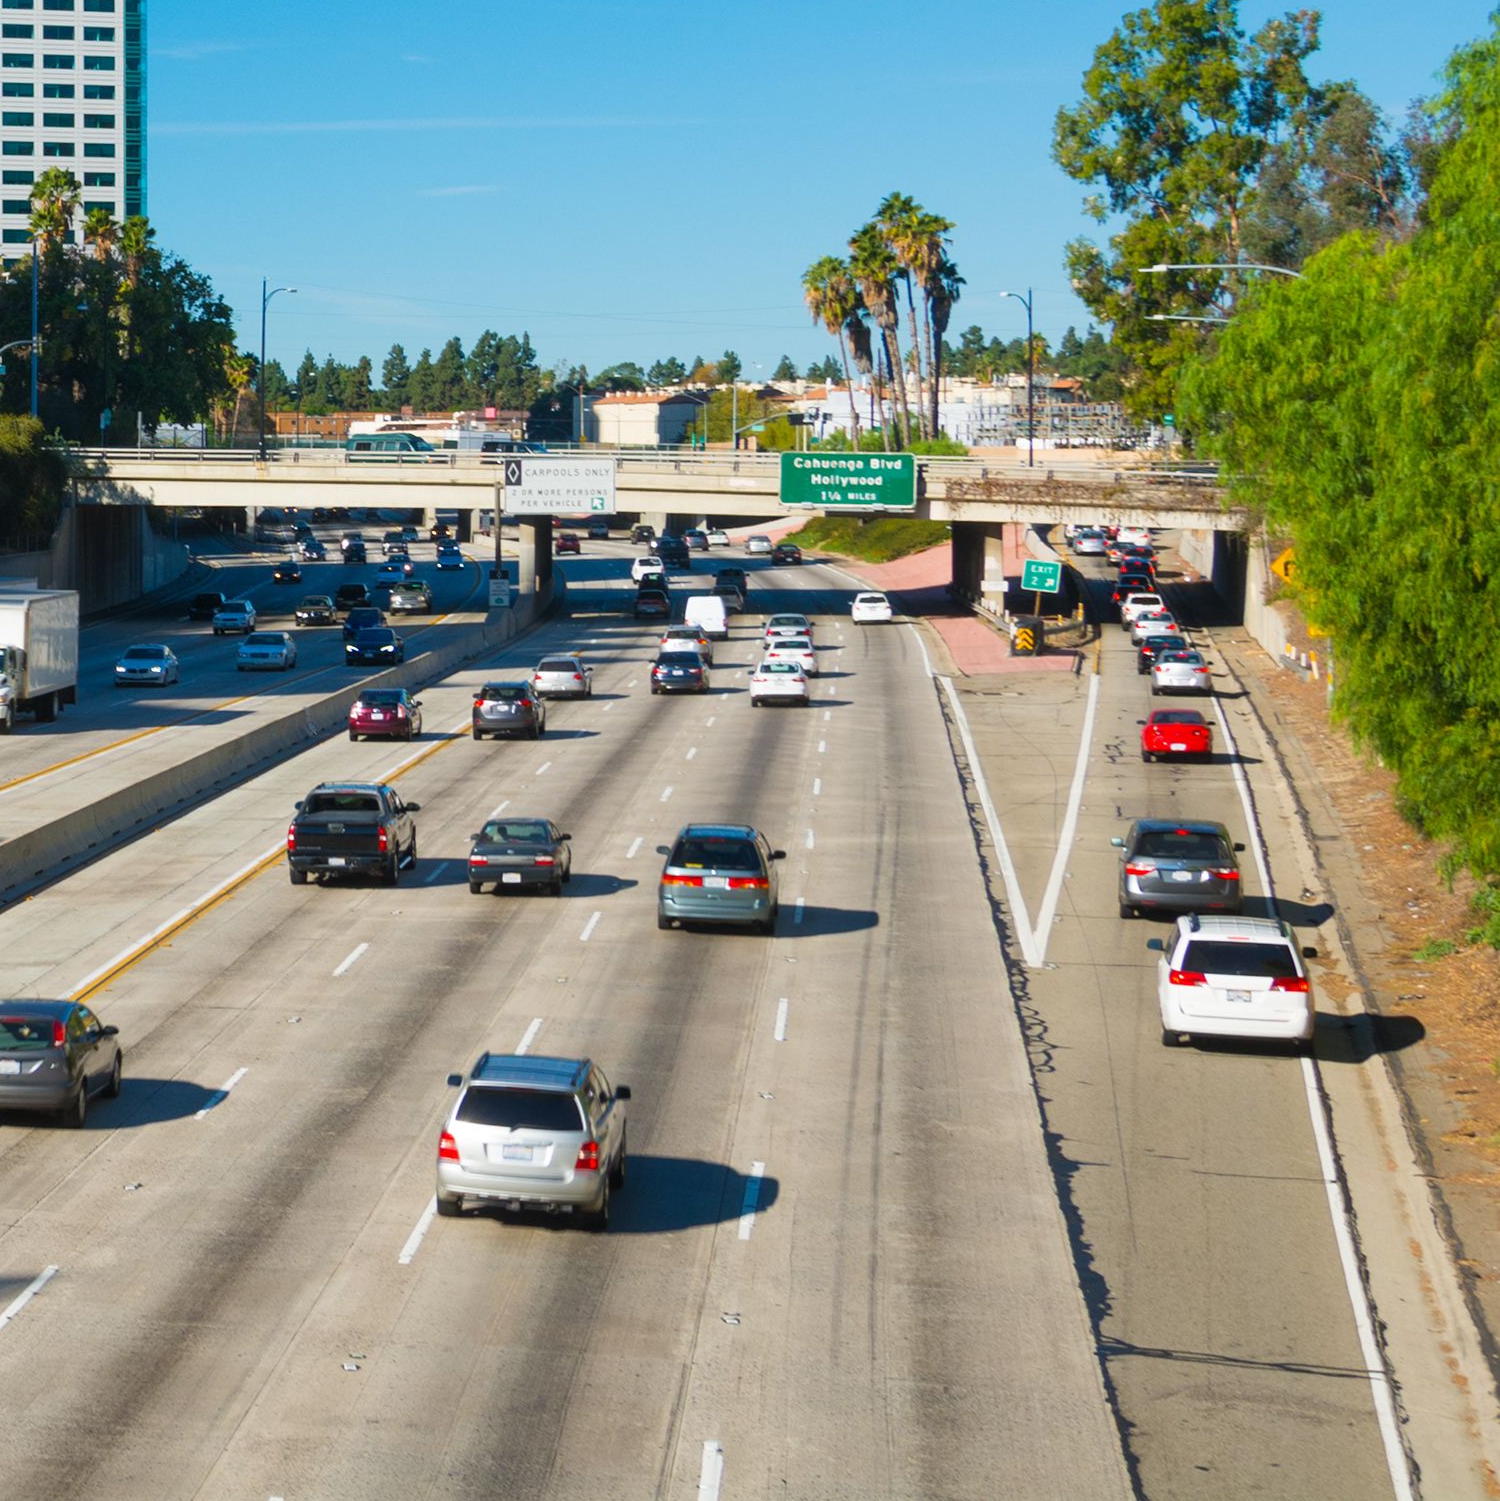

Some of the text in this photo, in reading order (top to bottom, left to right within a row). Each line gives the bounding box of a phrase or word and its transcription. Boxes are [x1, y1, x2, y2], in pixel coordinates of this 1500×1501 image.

[793, 457, 903, 472] Cahuenga Blvd
[524, 468, 611, 477] CARPOOLS ONLY
[810, 474, 883, 487] Hollywood
[565, 488, 608, 496] PERSONS
[847, 492, 877, 501] MILES
[520, 499, 583, 508] PER VEHICLE
[1031, 564, 1054, 575] EXIT
[1031, 576, 1038, 586] 2
